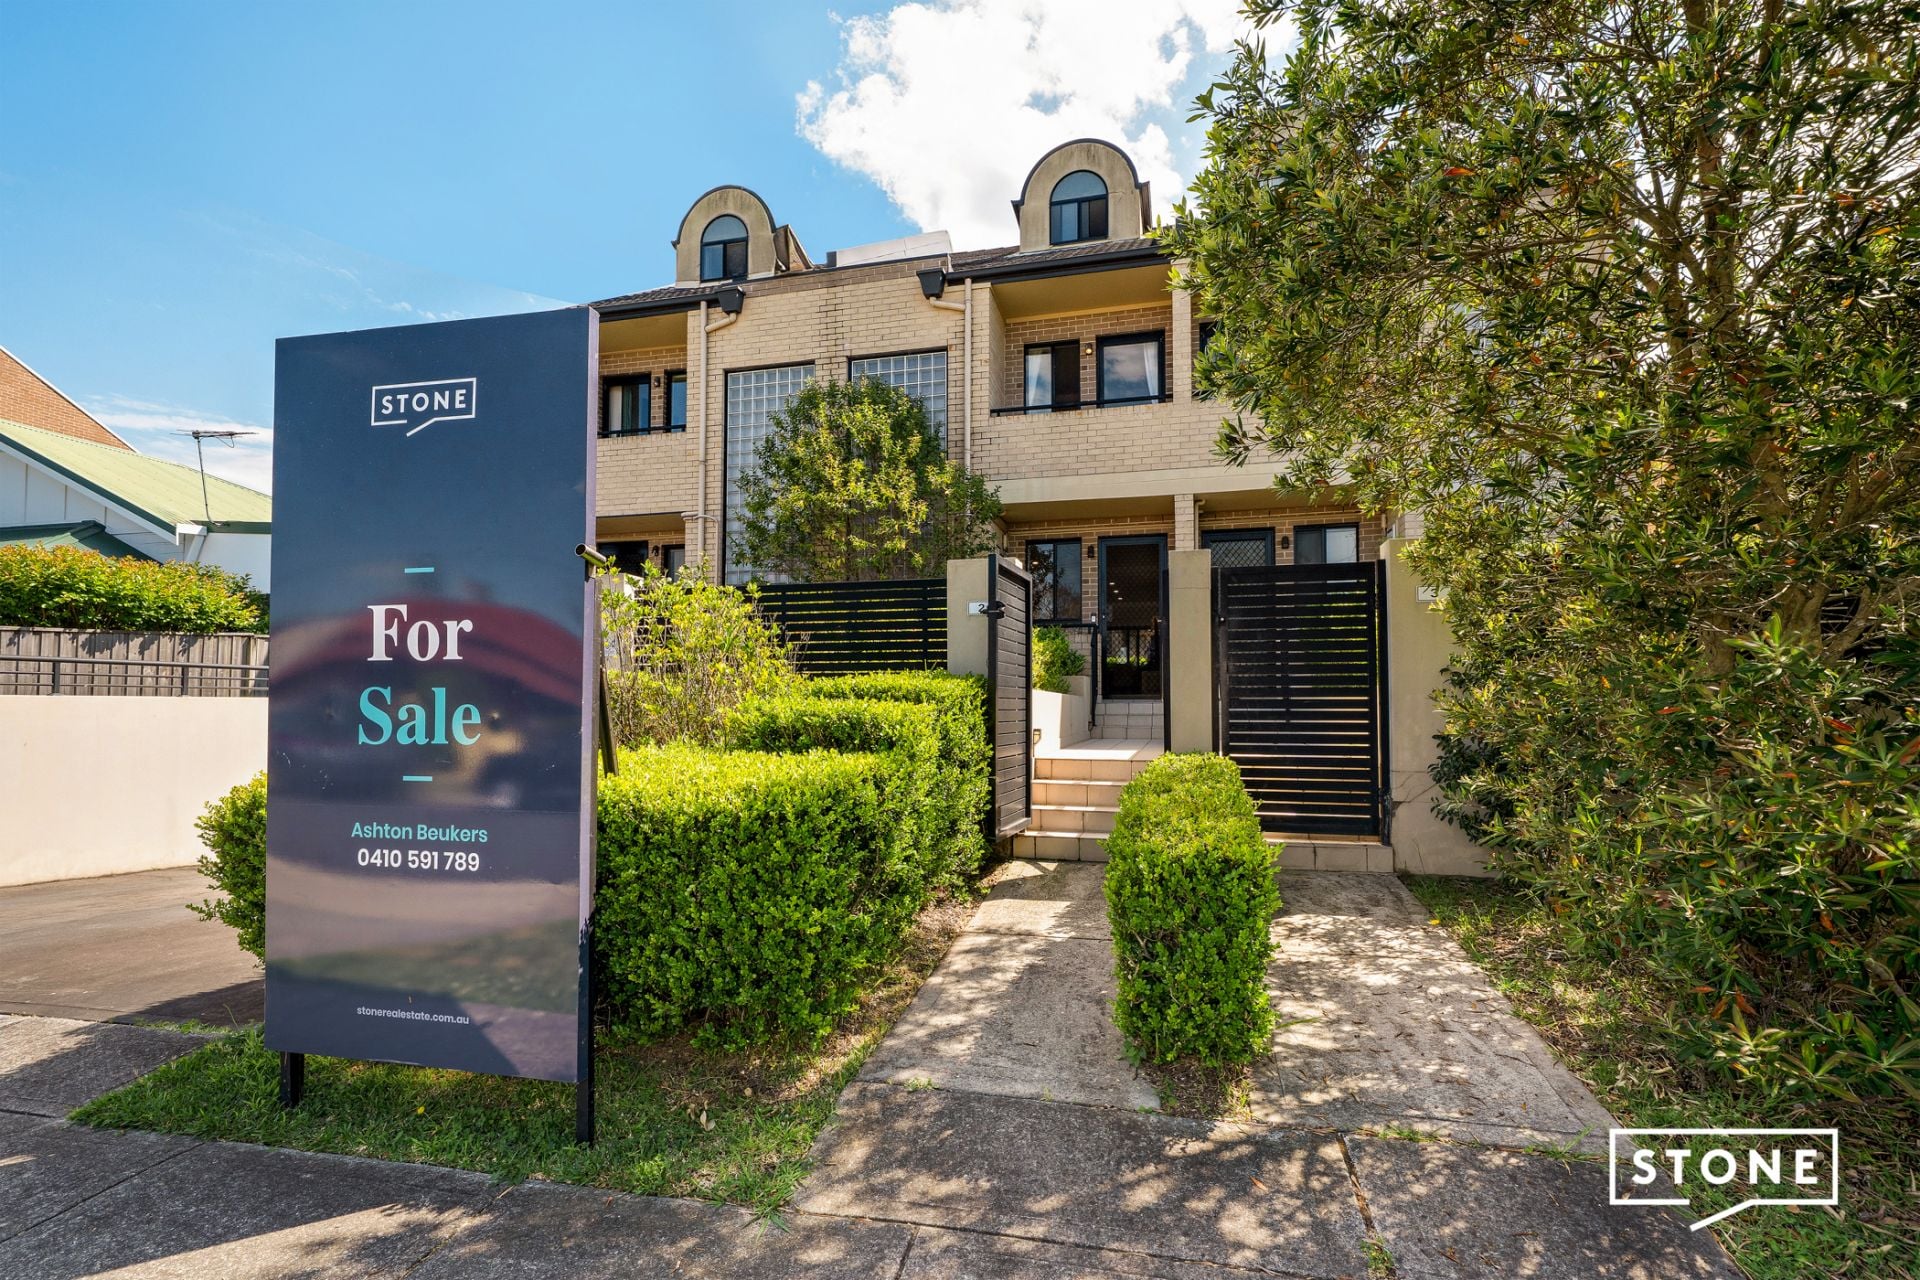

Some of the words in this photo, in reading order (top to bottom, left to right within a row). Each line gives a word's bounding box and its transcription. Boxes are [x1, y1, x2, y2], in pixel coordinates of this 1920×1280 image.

[381, 388, 467, 415] STONE
[367, 604, 474, 662] For
[358, 686, 482, 745] Sale
[351, 821, 413, 840] Ashton
[417, 824, 488, 843] Beukers
[357, 848, 402, 868] 0410
[407, 850, 439, 870] 591
[443, 851, 480, 872] 789
[356, 1006, 470, 1025] stonerealestate.com.au
